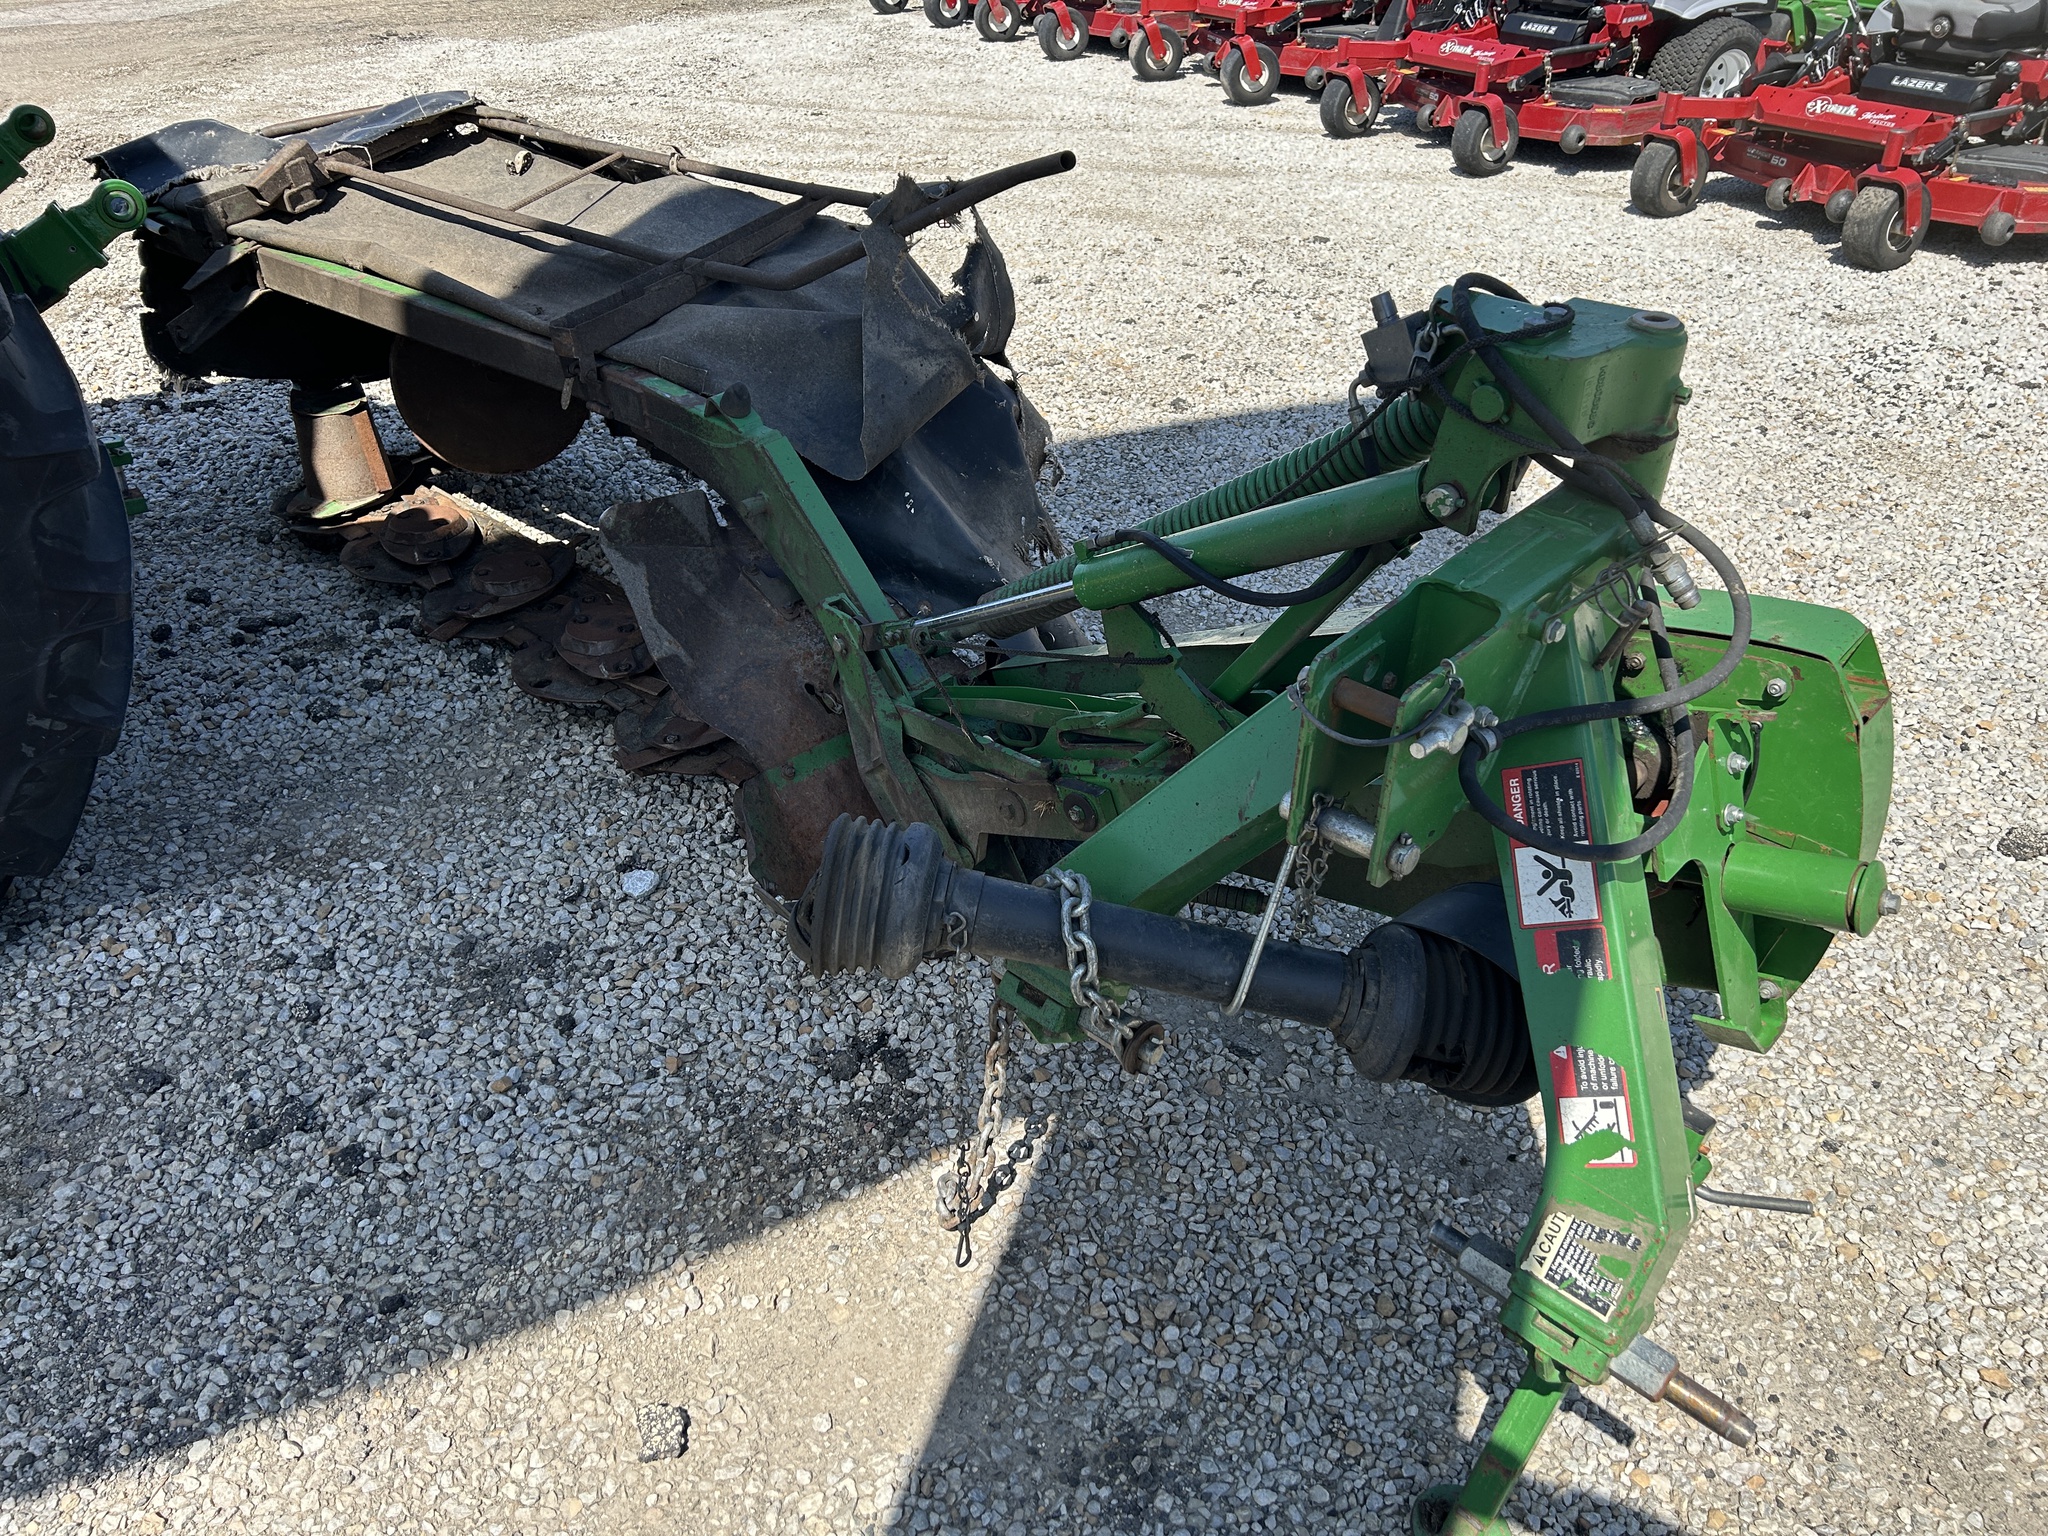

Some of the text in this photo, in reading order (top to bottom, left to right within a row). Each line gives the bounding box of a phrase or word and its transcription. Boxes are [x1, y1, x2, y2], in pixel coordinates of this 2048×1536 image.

[1520, 22, 1550, 34] LAZER
[1891, 75, 1948, 92] LAZER Z
[1770, 154, 1788, 167] 60
[1594, 958, 1605, 982] apidly.
[1578, 1060, 1587, 1080] avoid
[1587, 1050, 1597, 1082] machine
[1581, 1081, 1588, 1091] To
[1602, 1082, 1608, 1090] or
[1610, 1066, 1618, 1090] failure
[1539, 1212, 1566, 1253] CAUT
[1582, 1252, 1595, 1273] machin
